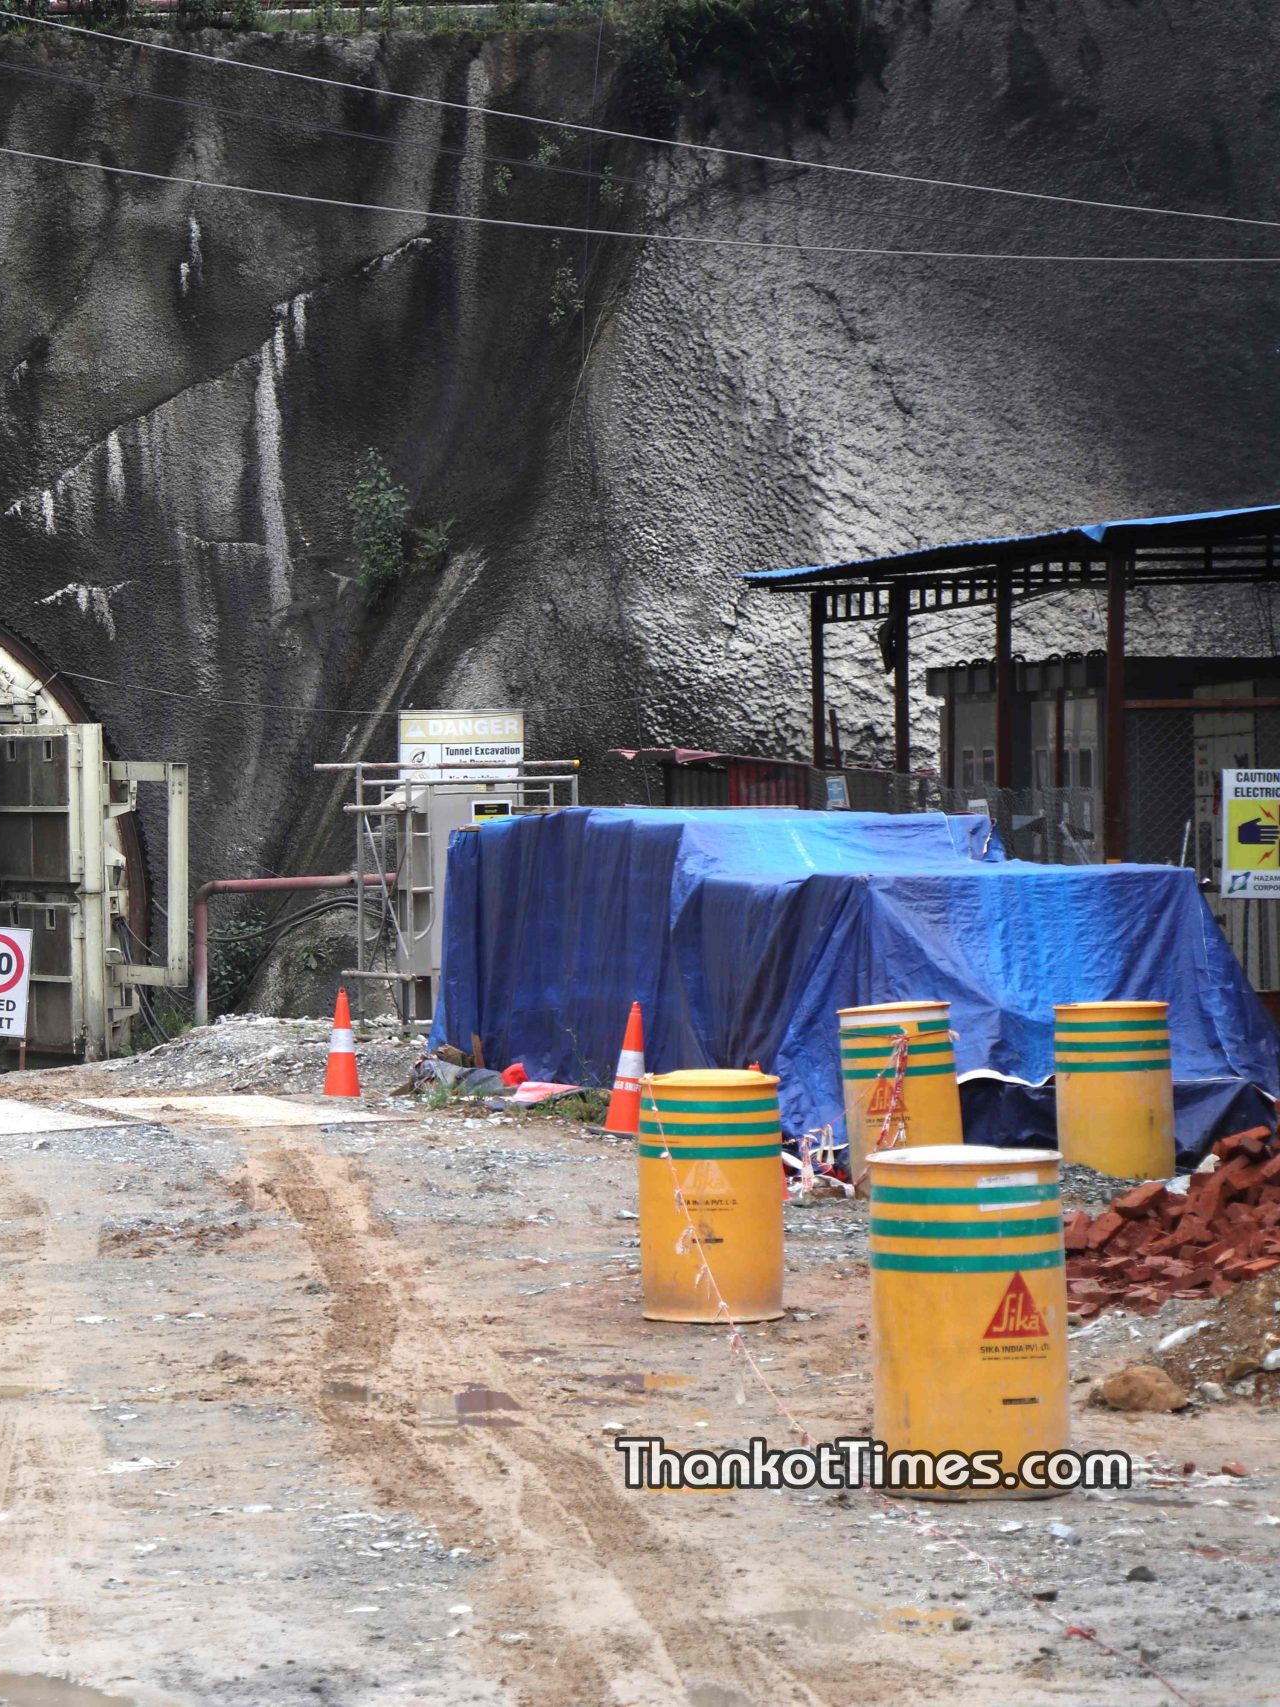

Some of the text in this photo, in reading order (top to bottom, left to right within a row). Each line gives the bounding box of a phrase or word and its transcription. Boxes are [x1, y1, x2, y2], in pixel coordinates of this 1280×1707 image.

[429, 718, 518, 736] DANGER
[445, 745, 520, 756] Tunnel Excavation
[992, 1292, 1040, 1332] Sika
[980, 1345, 1000, 1354] SIKA
[1002, 1344, 1024, 1353] INDIA
